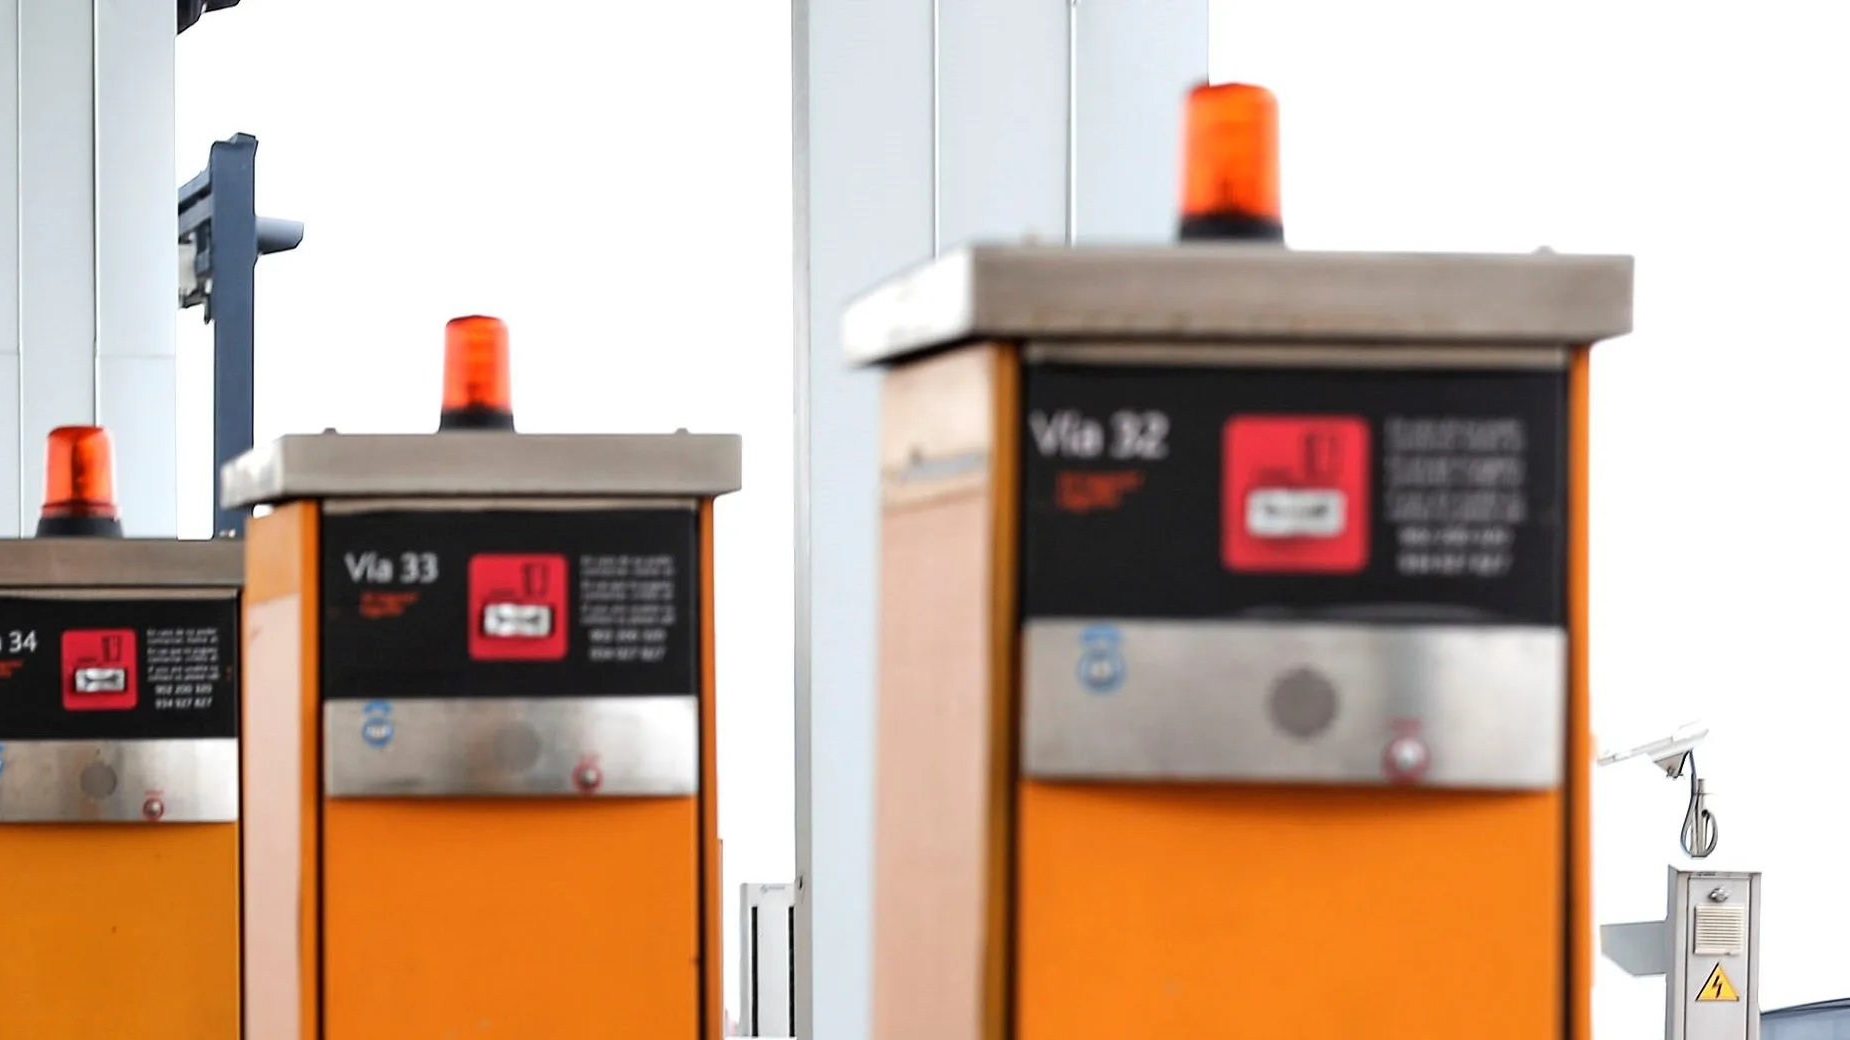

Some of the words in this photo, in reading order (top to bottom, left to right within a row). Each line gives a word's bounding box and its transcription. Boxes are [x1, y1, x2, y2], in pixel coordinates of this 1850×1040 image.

[1113, 411, 1170, 460] 32
[401, 551, 439, 583] 33
[9, 630, 37, 653] 34
